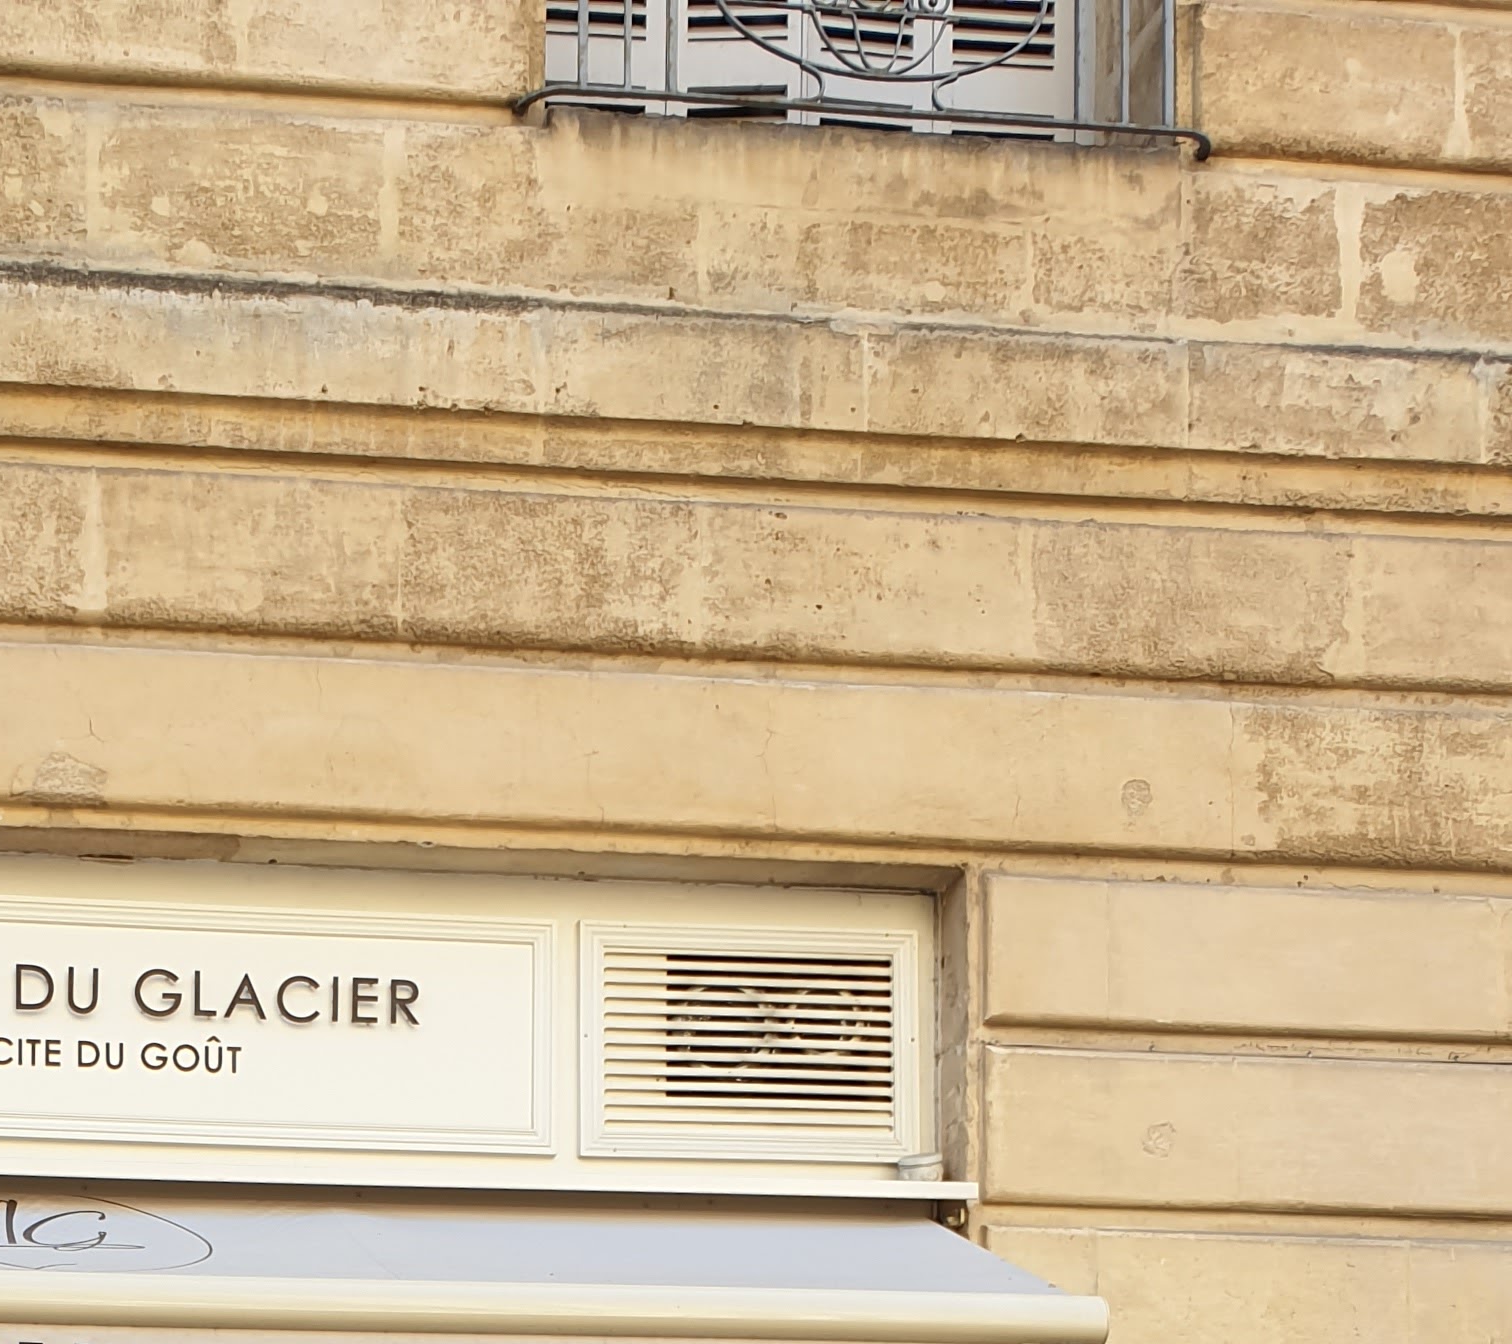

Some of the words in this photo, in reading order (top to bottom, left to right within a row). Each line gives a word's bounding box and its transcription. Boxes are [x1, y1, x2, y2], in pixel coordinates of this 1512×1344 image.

[14, 963, 100, 1016] DU
[133, 967, 421, 1026] GLACIER
[76, 1039, 125, 1071] DU
[139, 1034, 243, 1075] GOÛT
